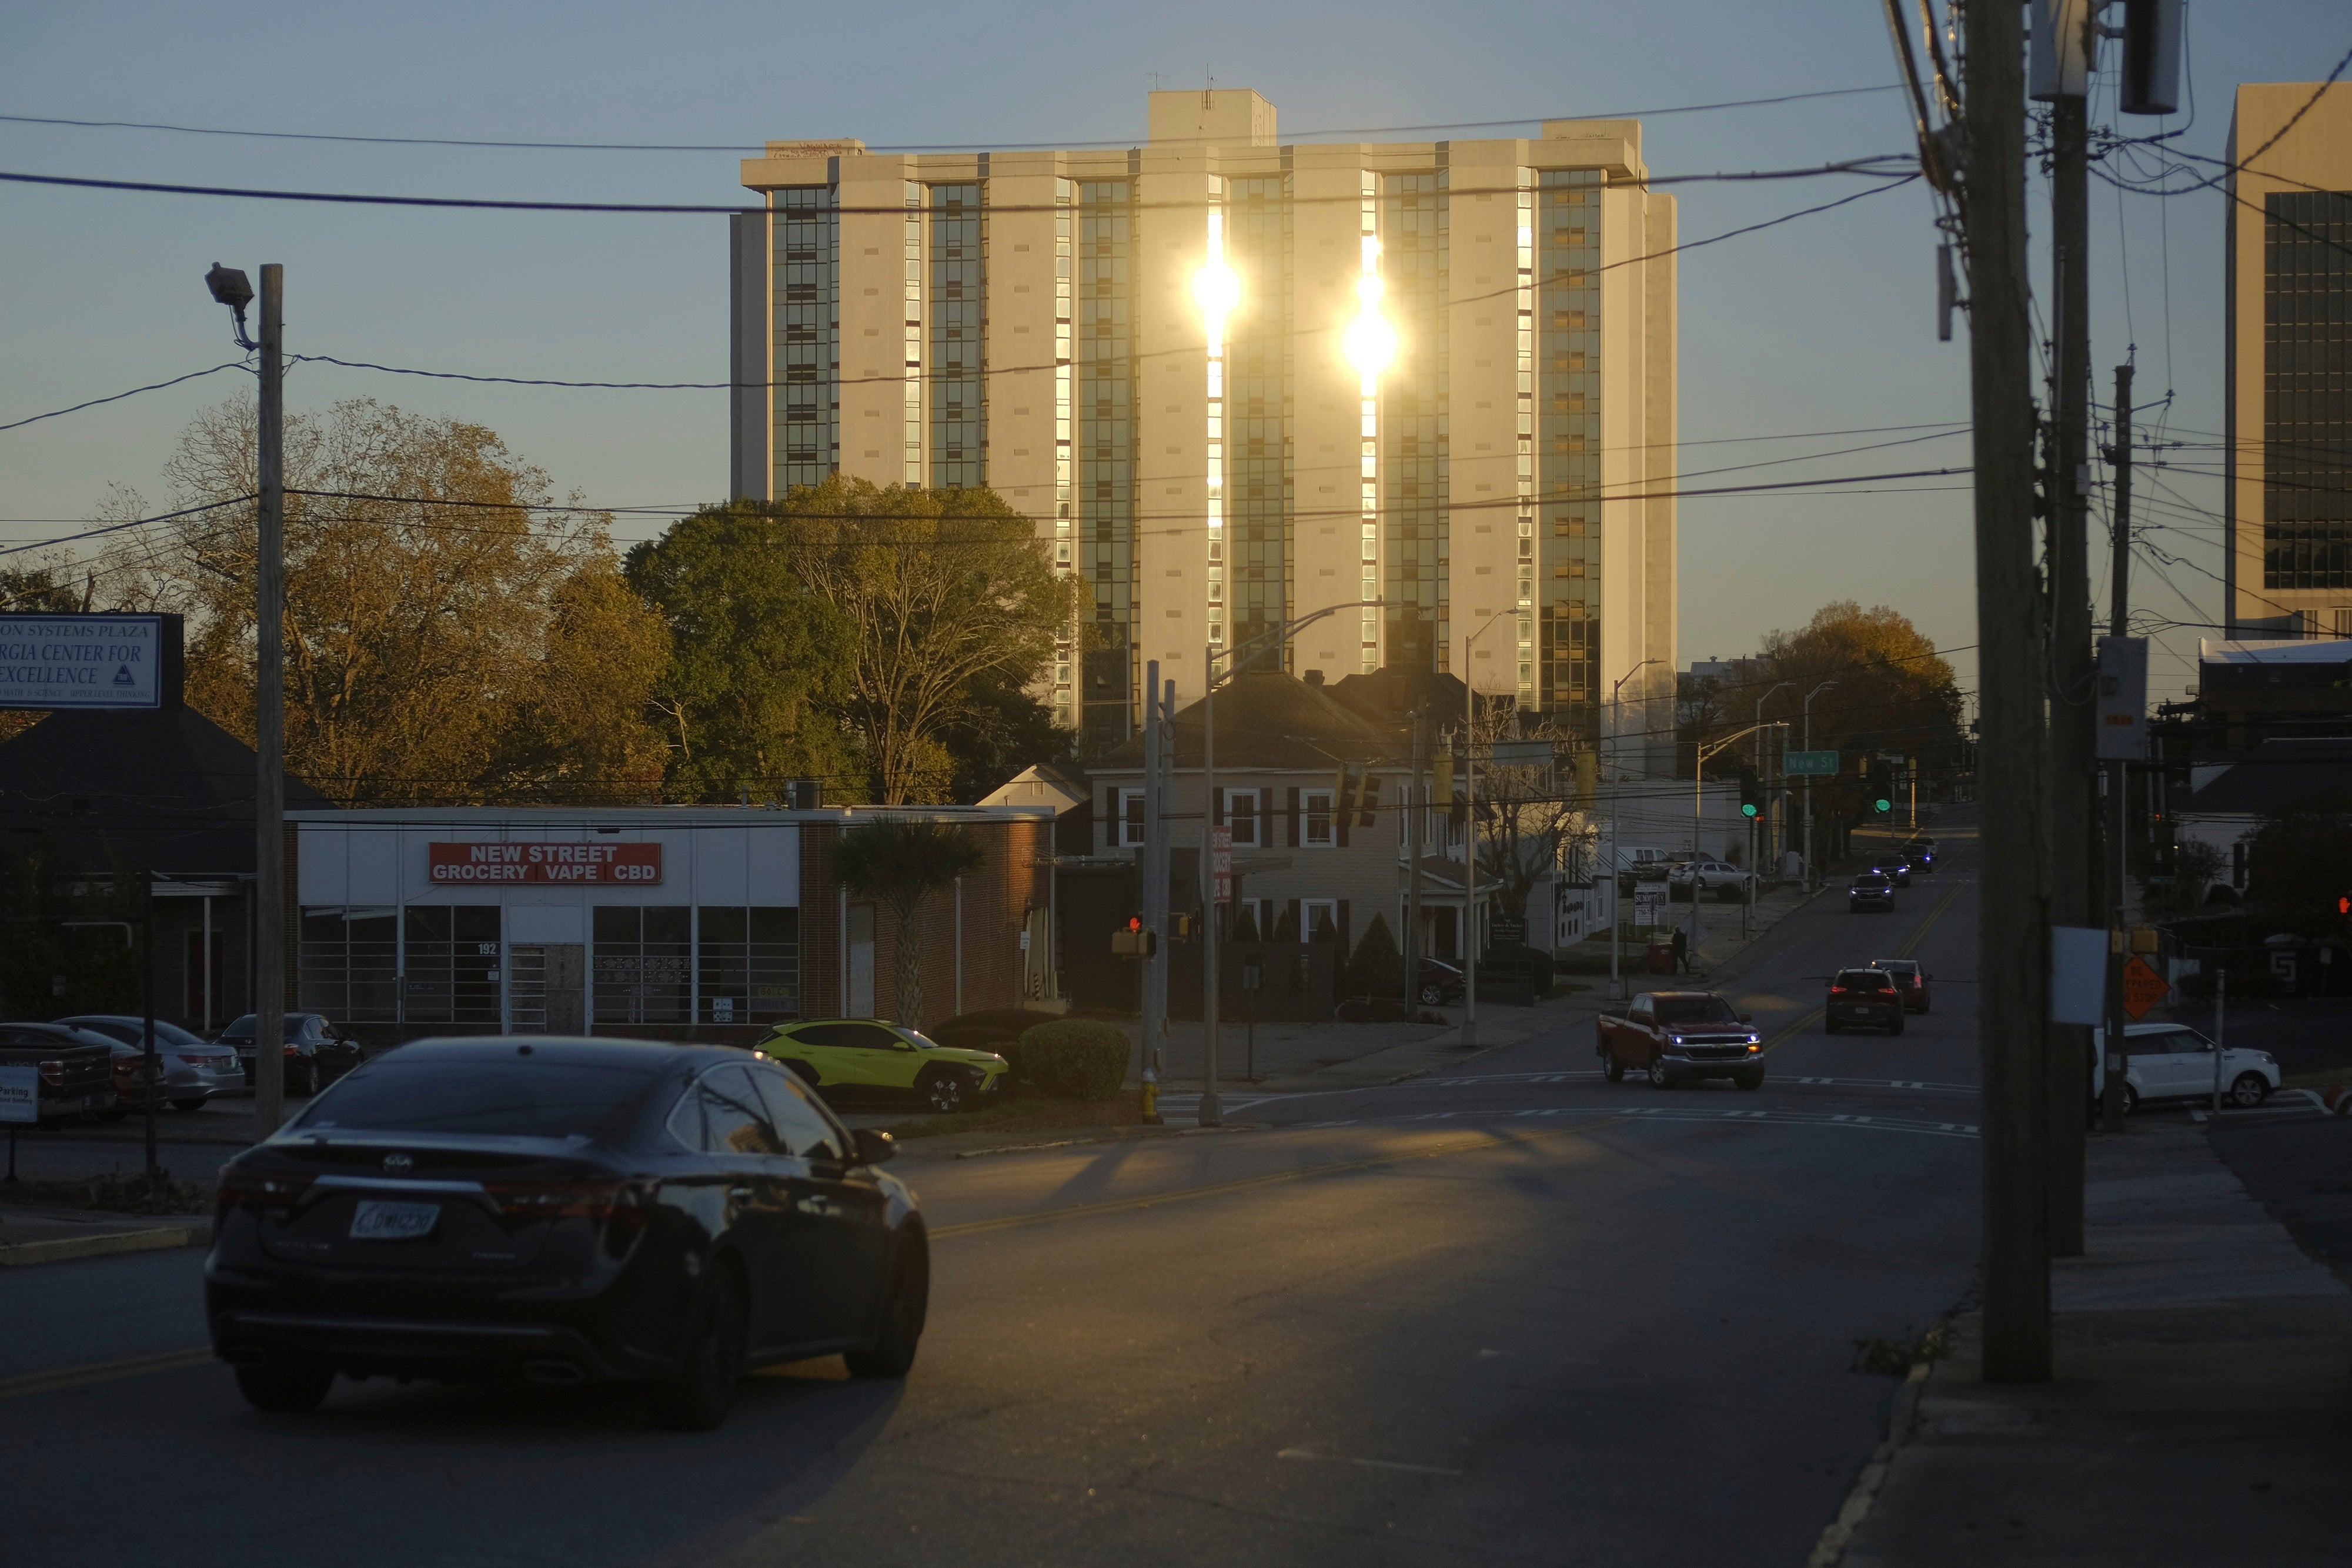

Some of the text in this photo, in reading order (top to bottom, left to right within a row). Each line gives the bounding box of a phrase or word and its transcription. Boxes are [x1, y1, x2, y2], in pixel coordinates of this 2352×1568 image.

[0, 624, 148, 637] ON SYSTEMS PLAZA
[42, 644, 103, 661] CENTER
[108, 646, 141, 662] FOR
[4, 688, 23, 697] MATH
[1789, 757, 1833, 768] New St
[470, 845, 617, 862] NEW STREET
[432, 864, 655, 880] GROCERY VAPE CBD
[478, 943, 496, 954] 192
[2131, 966, 2143, 975] BE
[2133, 992, 2157, 1002] STOP
